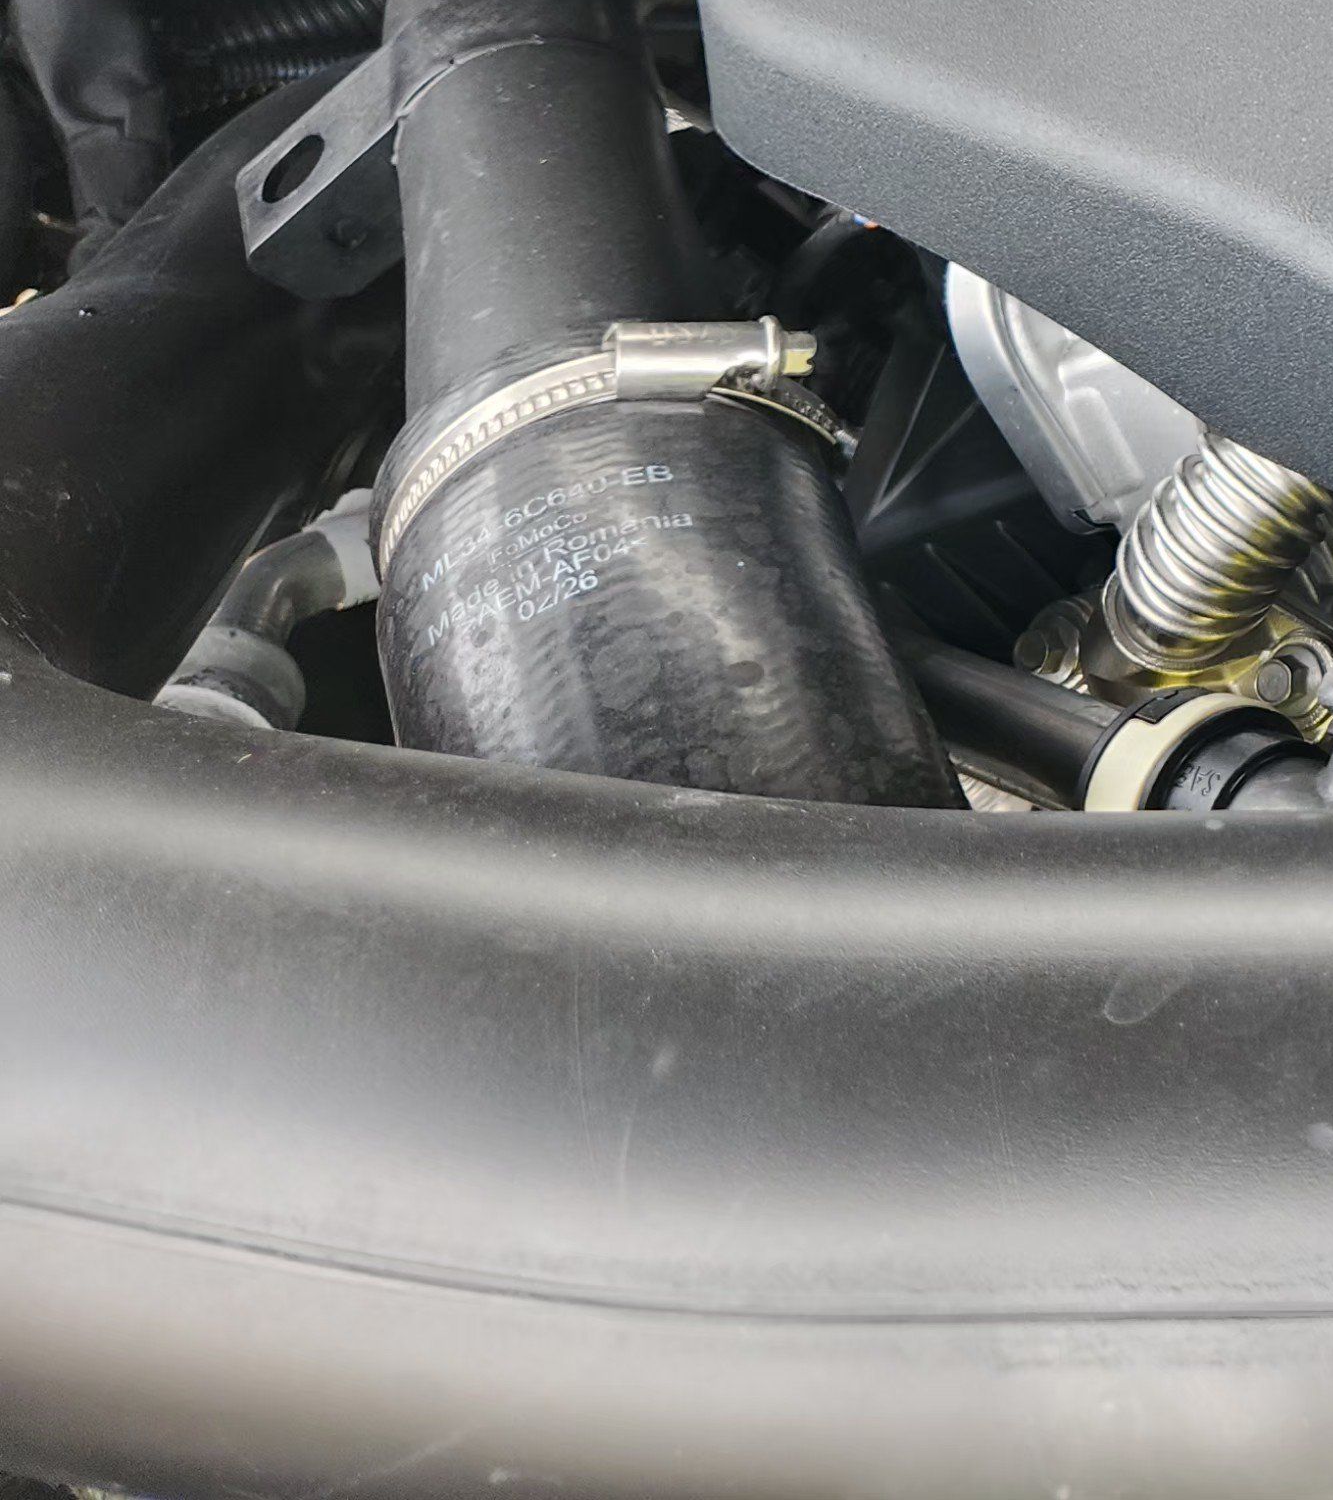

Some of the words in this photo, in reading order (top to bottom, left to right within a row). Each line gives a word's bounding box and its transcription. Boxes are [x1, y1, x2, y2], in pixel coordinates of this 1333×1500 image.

[427, 577, 500, 647] Made
[509, 559, 536, 584] in
[543, 511, 695, 564] Romania
